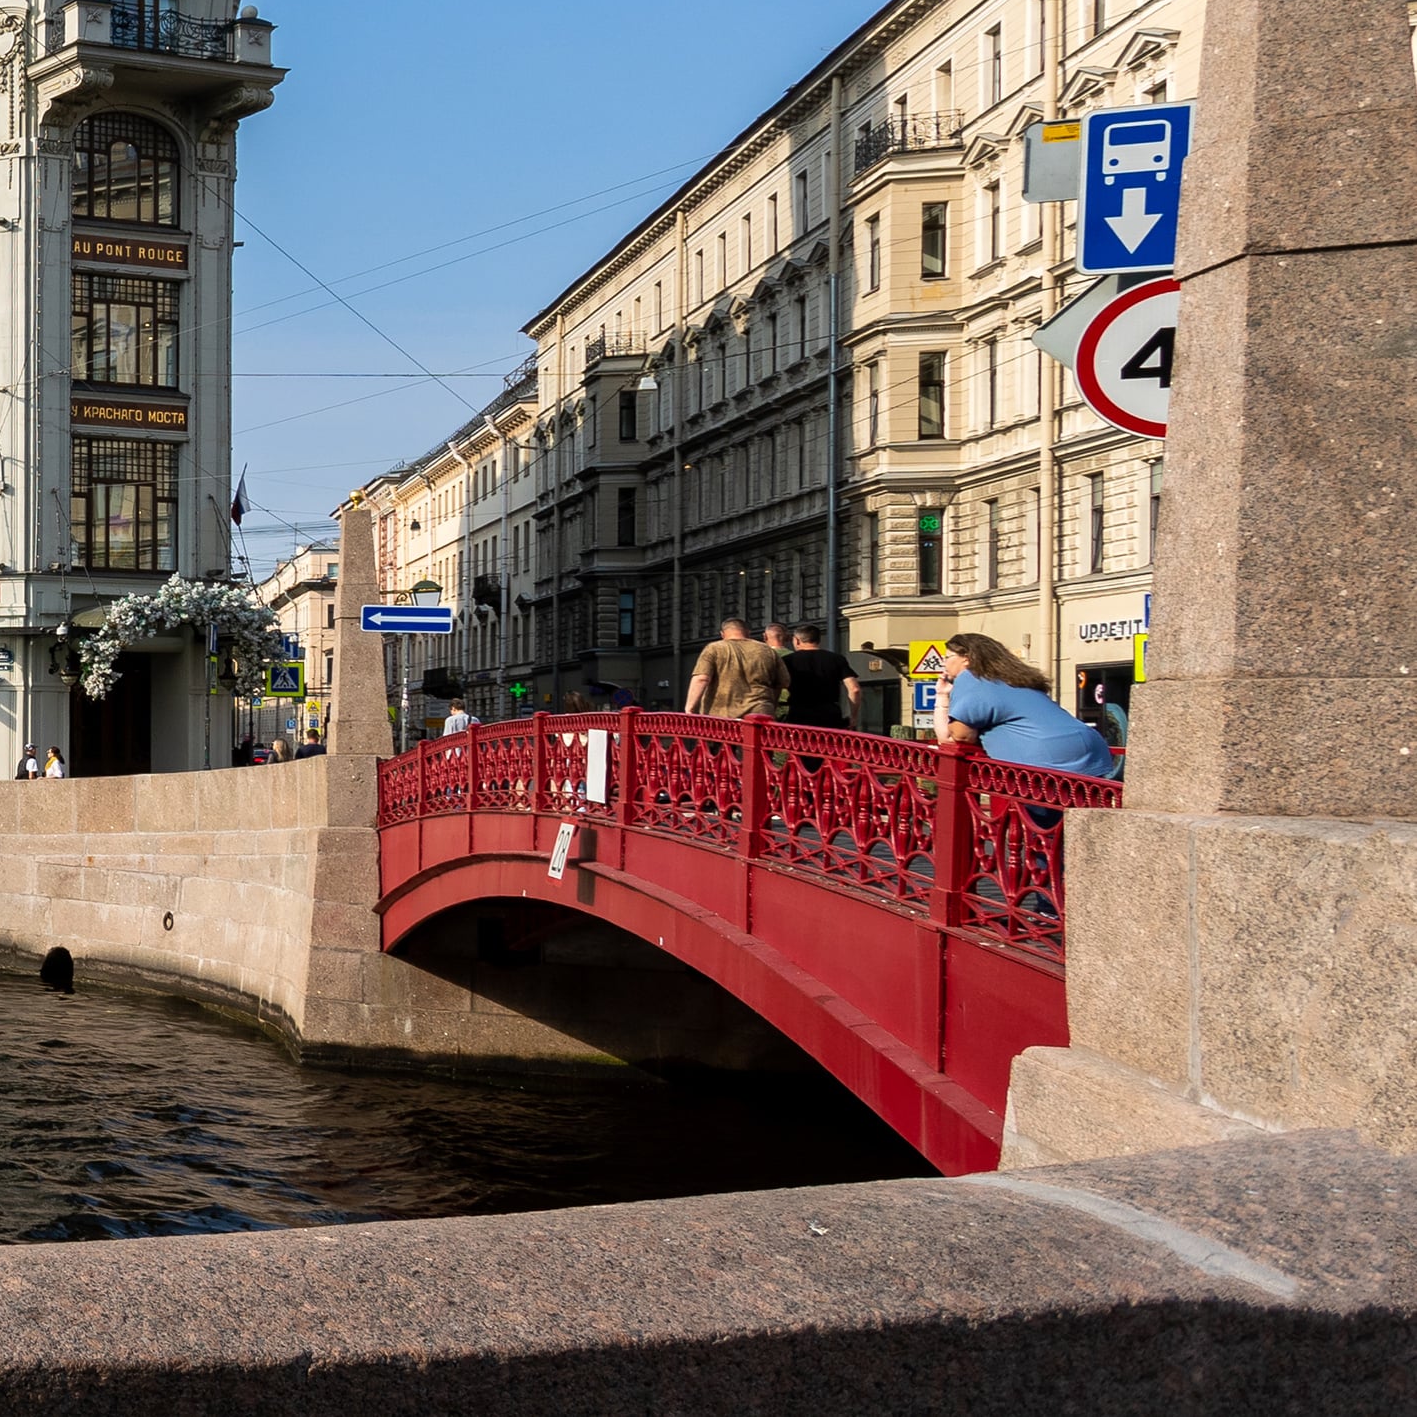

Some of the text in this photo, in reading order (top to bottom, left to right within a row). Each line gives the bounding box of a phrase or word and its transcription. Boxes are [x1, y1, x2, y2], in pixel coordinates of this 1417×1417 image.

[74, 241, 184, 263] AU PONT ROUGE
[71, 405, 185, 424] У КРАСНАГО МОСТА
[1079, 619, 1143, 640] UPPETIT
